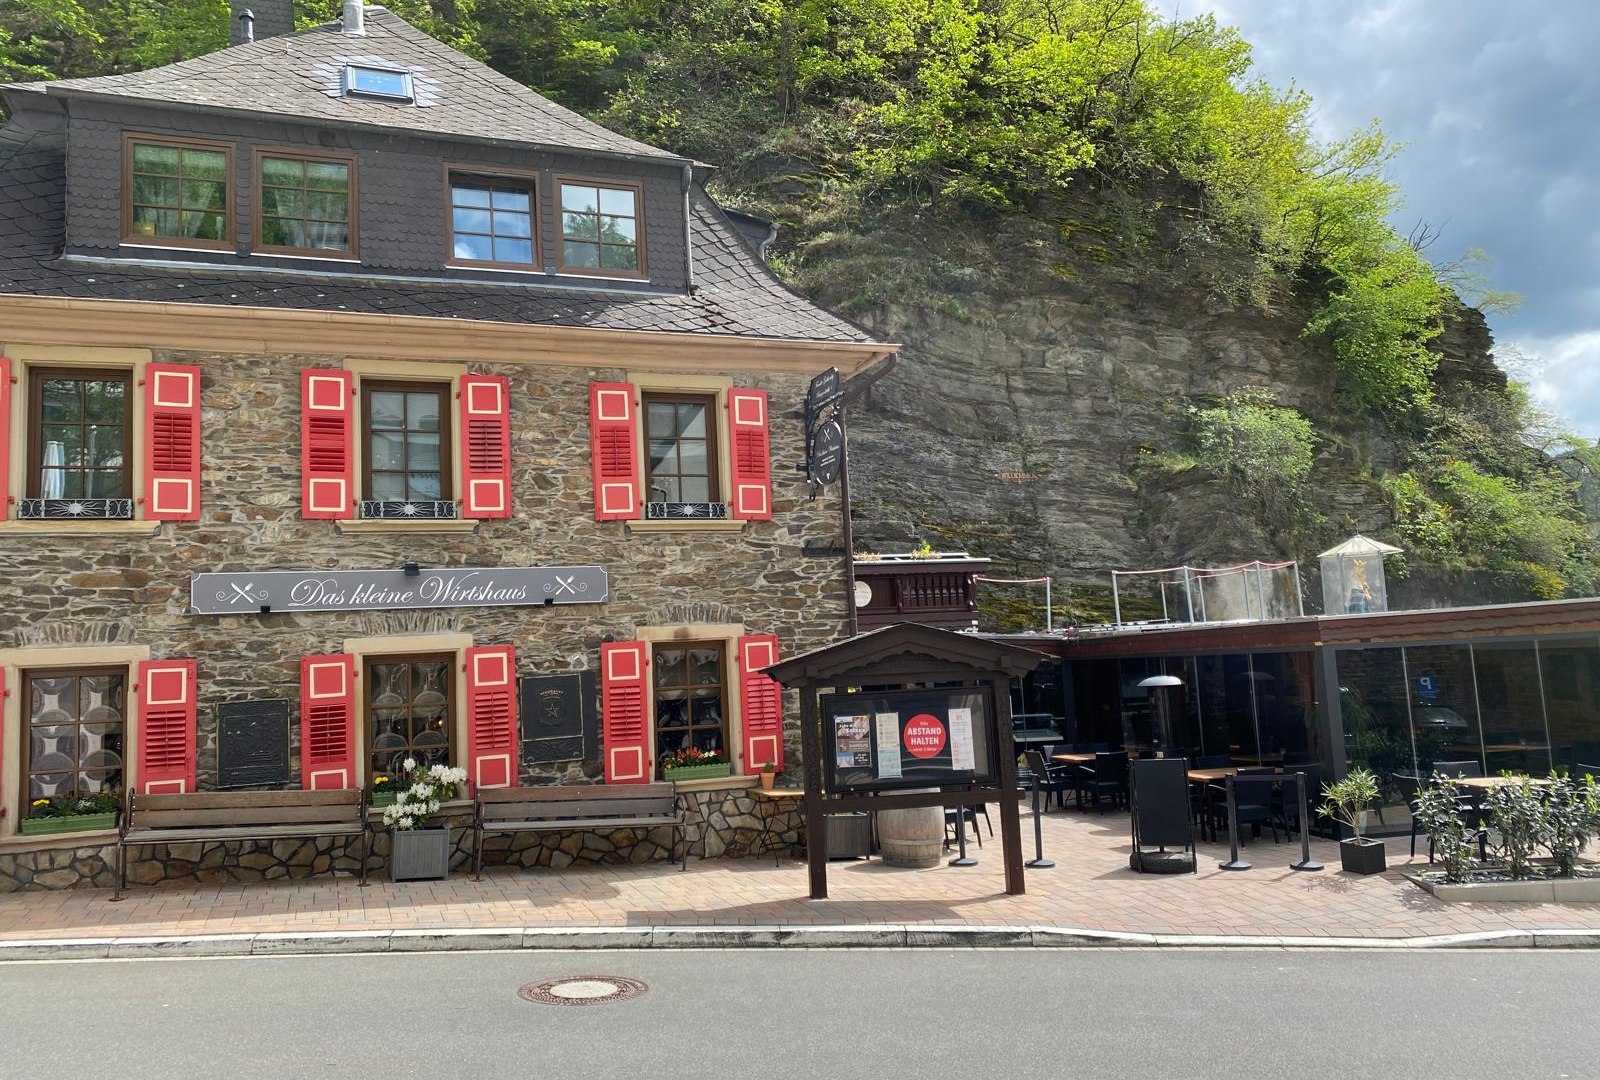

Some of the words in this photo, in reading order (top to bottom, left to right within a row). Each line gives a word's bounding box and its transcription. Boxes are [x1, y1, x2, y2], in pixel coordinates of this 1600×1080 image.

[288, 579, 346, 606] Das
[348, 583, 414, 605] kleine
[419, 571, 527, 603] Wirtshaus
[908, 727, 942, 736] ABSTAND
[911, 737, 940, 746] HALTEN
